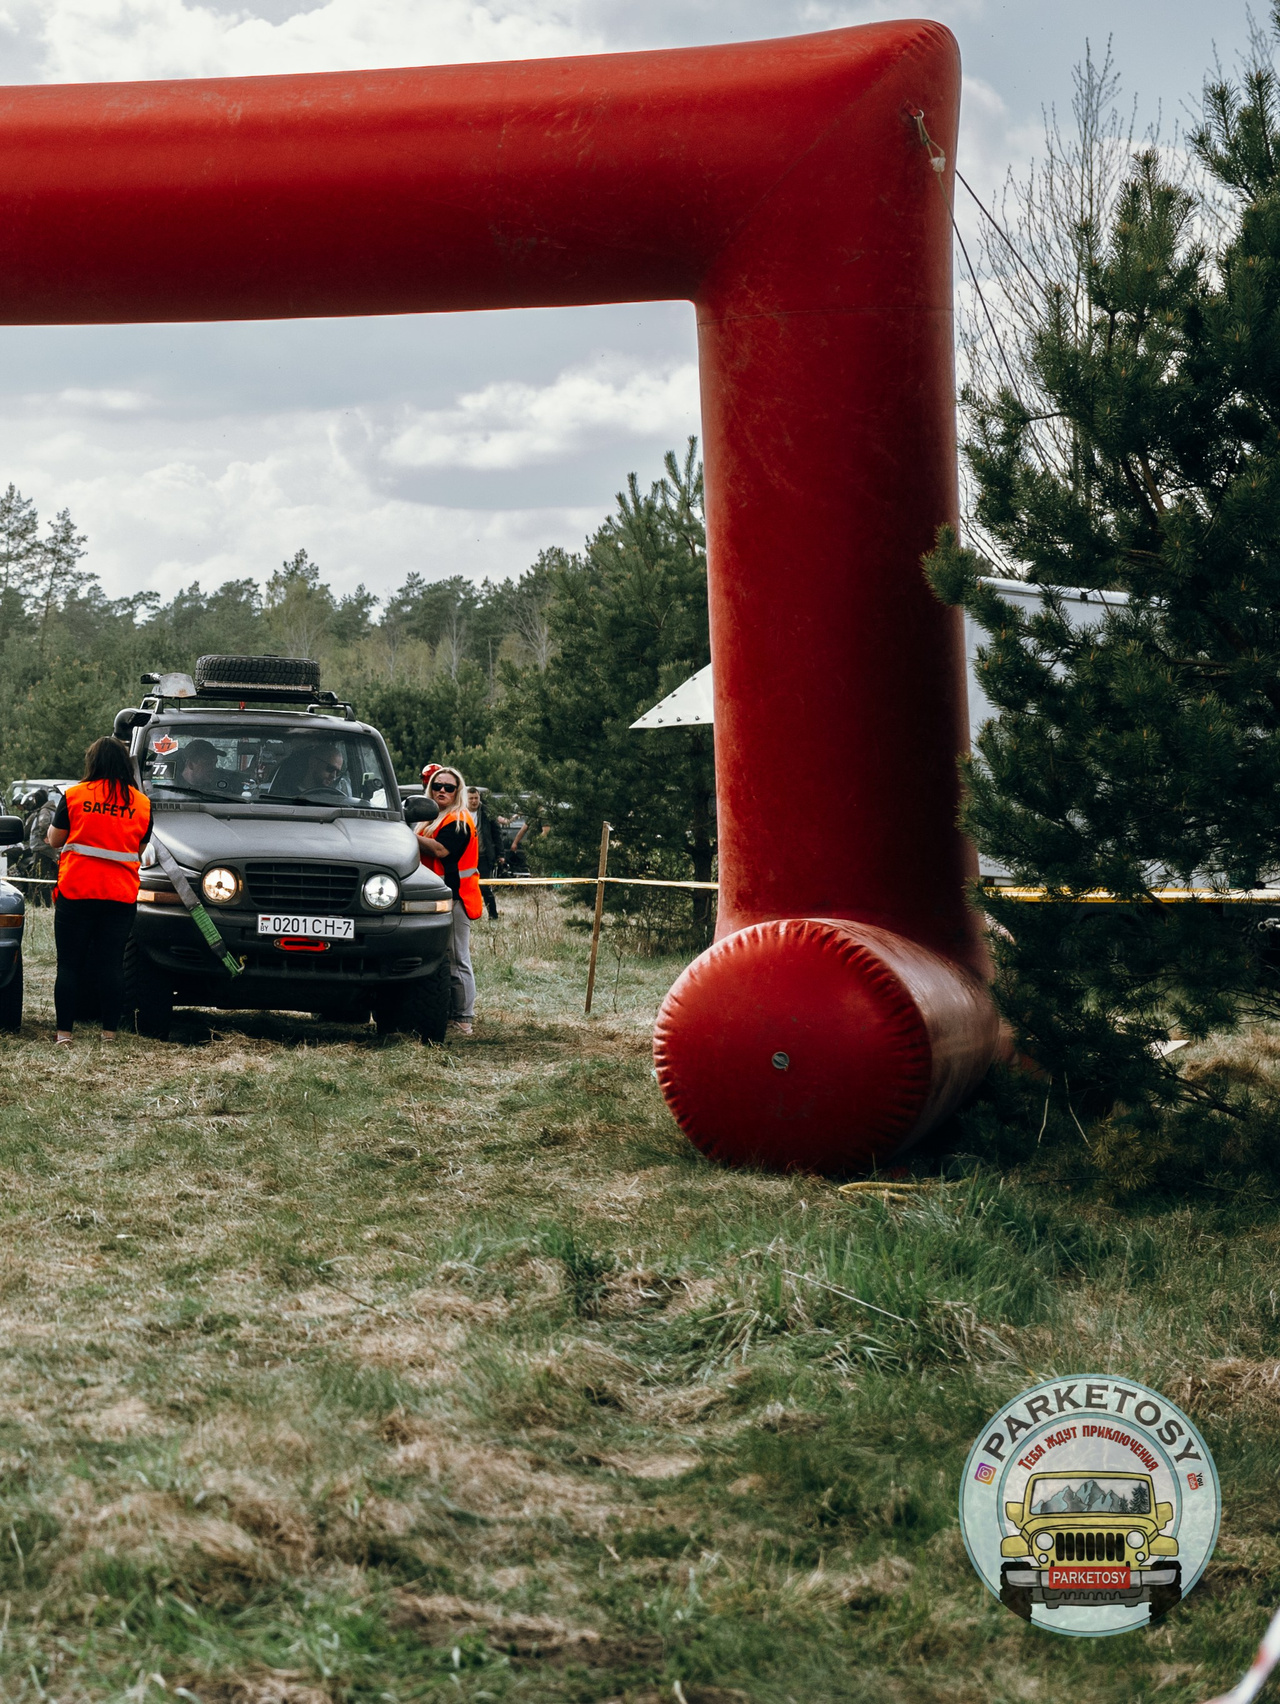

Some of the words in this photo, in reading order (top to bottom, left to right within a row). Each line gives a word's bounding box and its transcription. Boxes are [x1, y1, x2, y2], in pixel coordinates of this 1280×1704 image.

[152, 764, 168, 775] 77
[83, 800, 136, 819] SAFETY
[273, 917, 307, 934] 0201
[312, 919, 351, 936] CH-7
